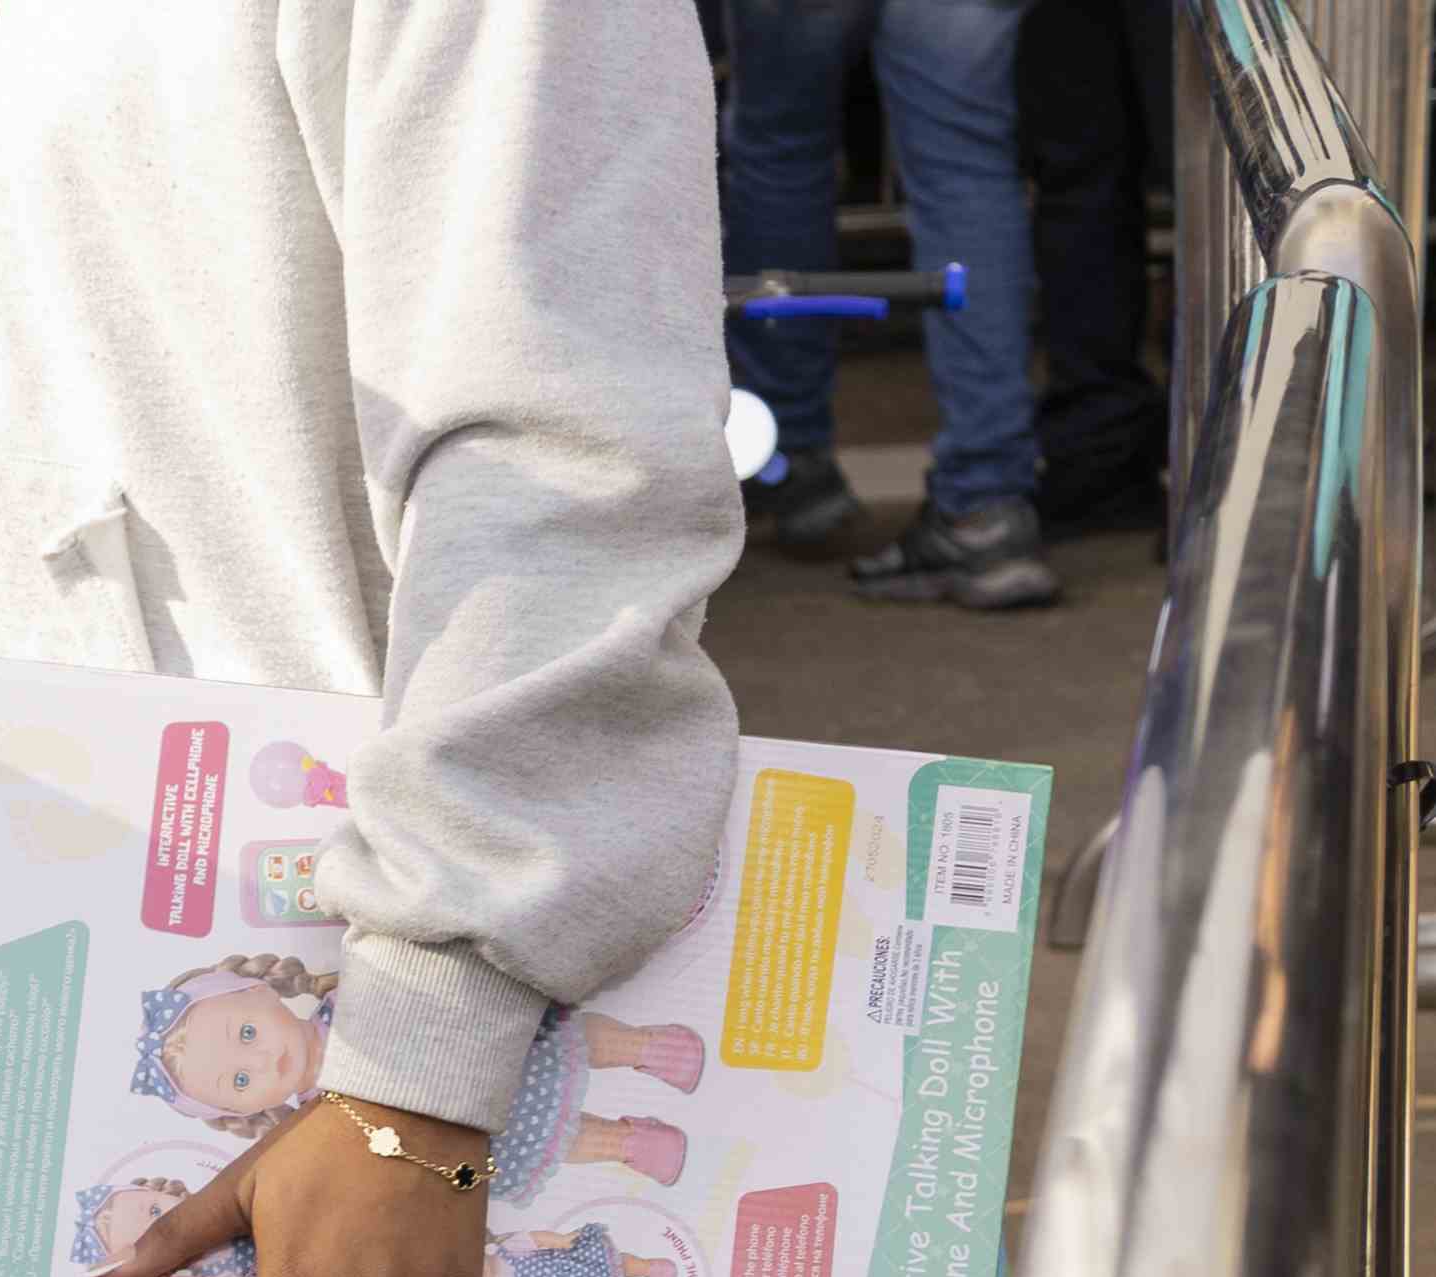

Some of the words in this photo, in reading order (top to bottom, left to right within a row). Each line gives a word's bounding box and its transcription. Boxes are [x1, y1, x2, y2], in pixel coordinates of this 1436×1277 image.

[183, 727, 204, 800] CELLPHONE
[156, 783, 178, 866] INTERACTIVE
[179, 802, 195, 836] WITH
[196, 772, 218, 855] MICROPHONE
[1008, 814, 1021, 852] CHINA
[175, 837, 191, 869] DOLL
[193, 857, 208, 885] AND
[1006, 854, 1017, 866] IN
[168, 872, 186, 925] TALKING
[934, 865, 946, 894] ITEM
[1002, 870, 1015, 904] MADE
[868, 935, 889, 1008] PRECAUCIONES:
[926, 947, 962, 1026] With
[918, 1037, 952, 1097] Doll
[952, 979, 1008, 1161] Microphone
[905, 1109, 952, 1219] Talking
[944, 1170, 979, 1232] And
[661, 1226, 691, 1259] PHONE
[745, 1222, 762, 1260] phone
[792, 1260, 804, 1273] al
